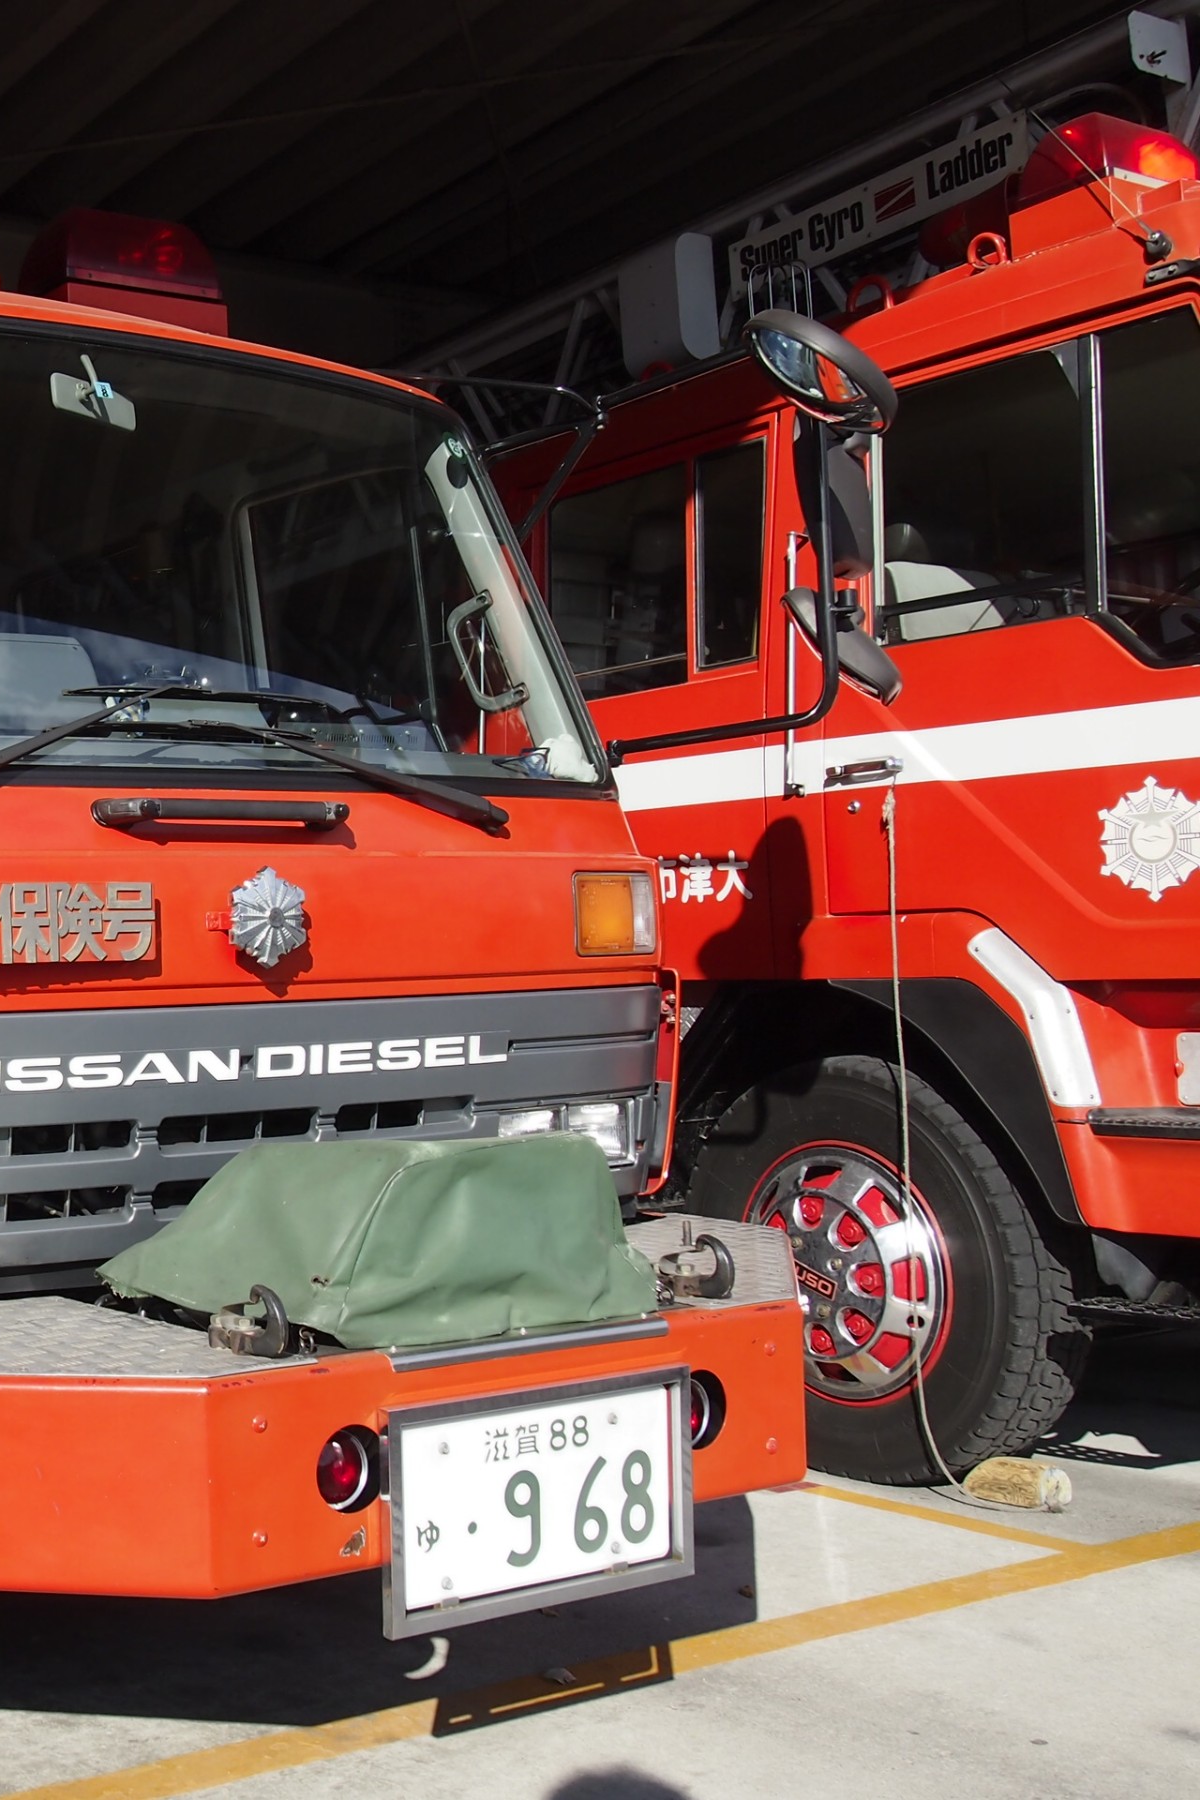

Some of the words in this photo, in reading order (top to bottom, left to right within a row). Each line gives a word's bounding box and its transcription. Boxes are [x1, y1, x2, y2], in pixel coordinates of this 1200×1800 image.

[808, 200, 864, 253] Gyro
[926, 131, 1013, 200] Ladder
[255, 1034, 509, 1081] DIESEL
[794, 1264, 833, 1296] USO
[416, 1520, 440, 1553] ゆ
